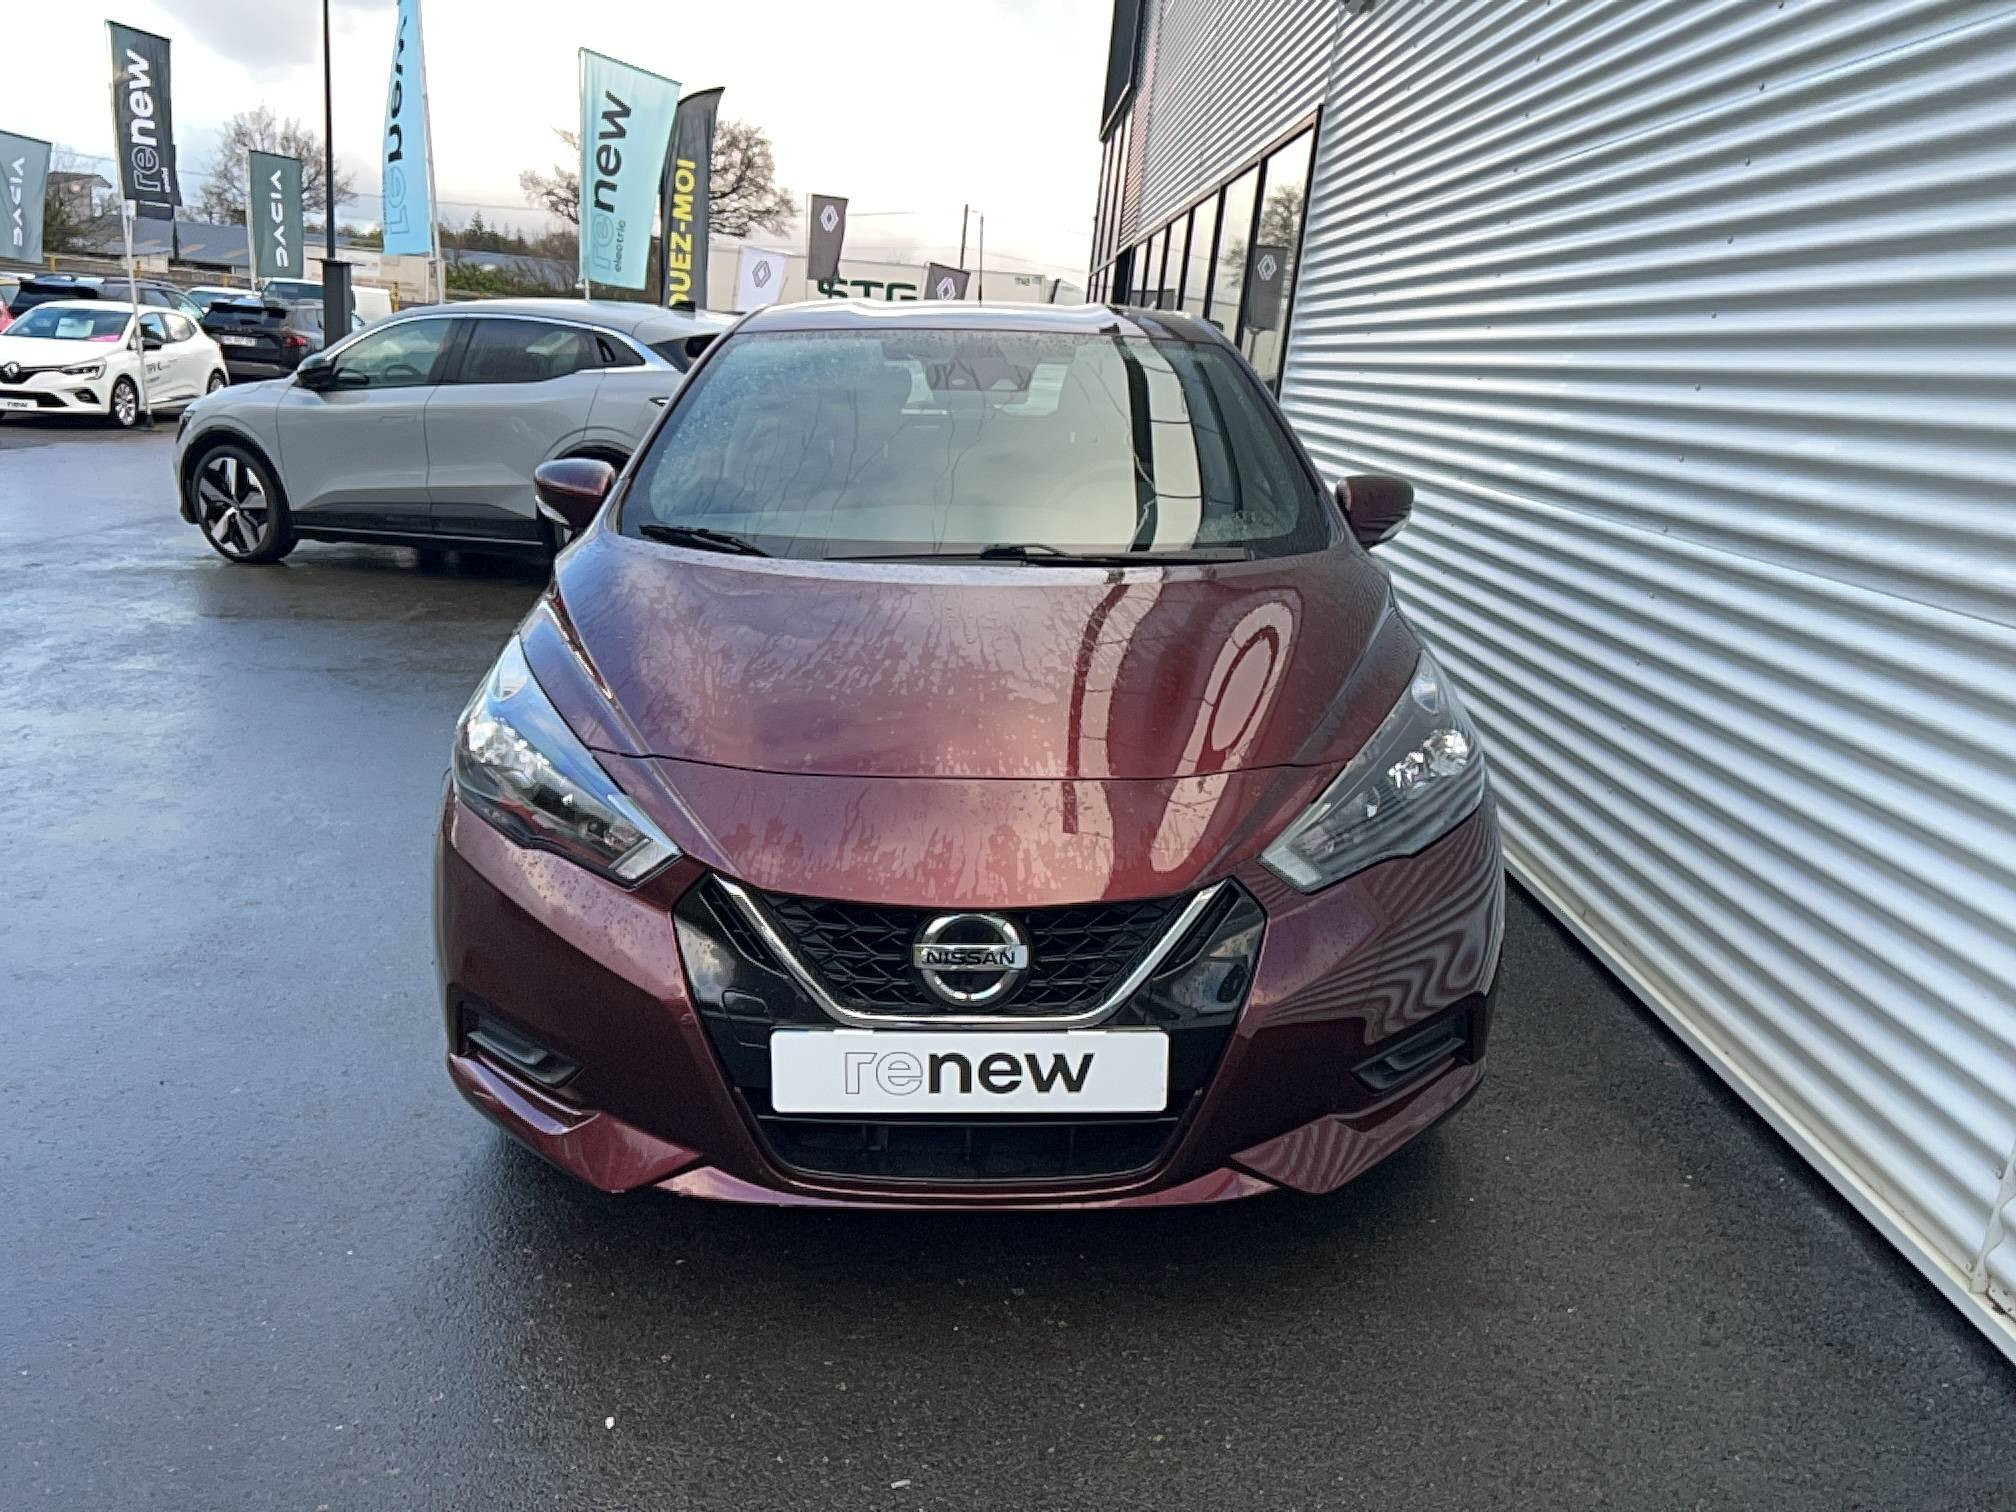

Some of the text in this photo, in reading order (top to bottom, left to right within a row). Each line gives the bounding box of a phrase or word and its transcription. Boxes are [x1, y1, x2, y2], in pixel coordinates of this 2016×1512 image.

[126, 48, 161, 192] renew
[9, 157, 25, 247] DACIA
[269, 169, 289, 268] DACIA
[591, 90, 631, 271] renew
[613, 219, 626, 273] electric
[924, 950, 1015, 965] NISSAN
[845, 1051, 1094, 1095] renew
